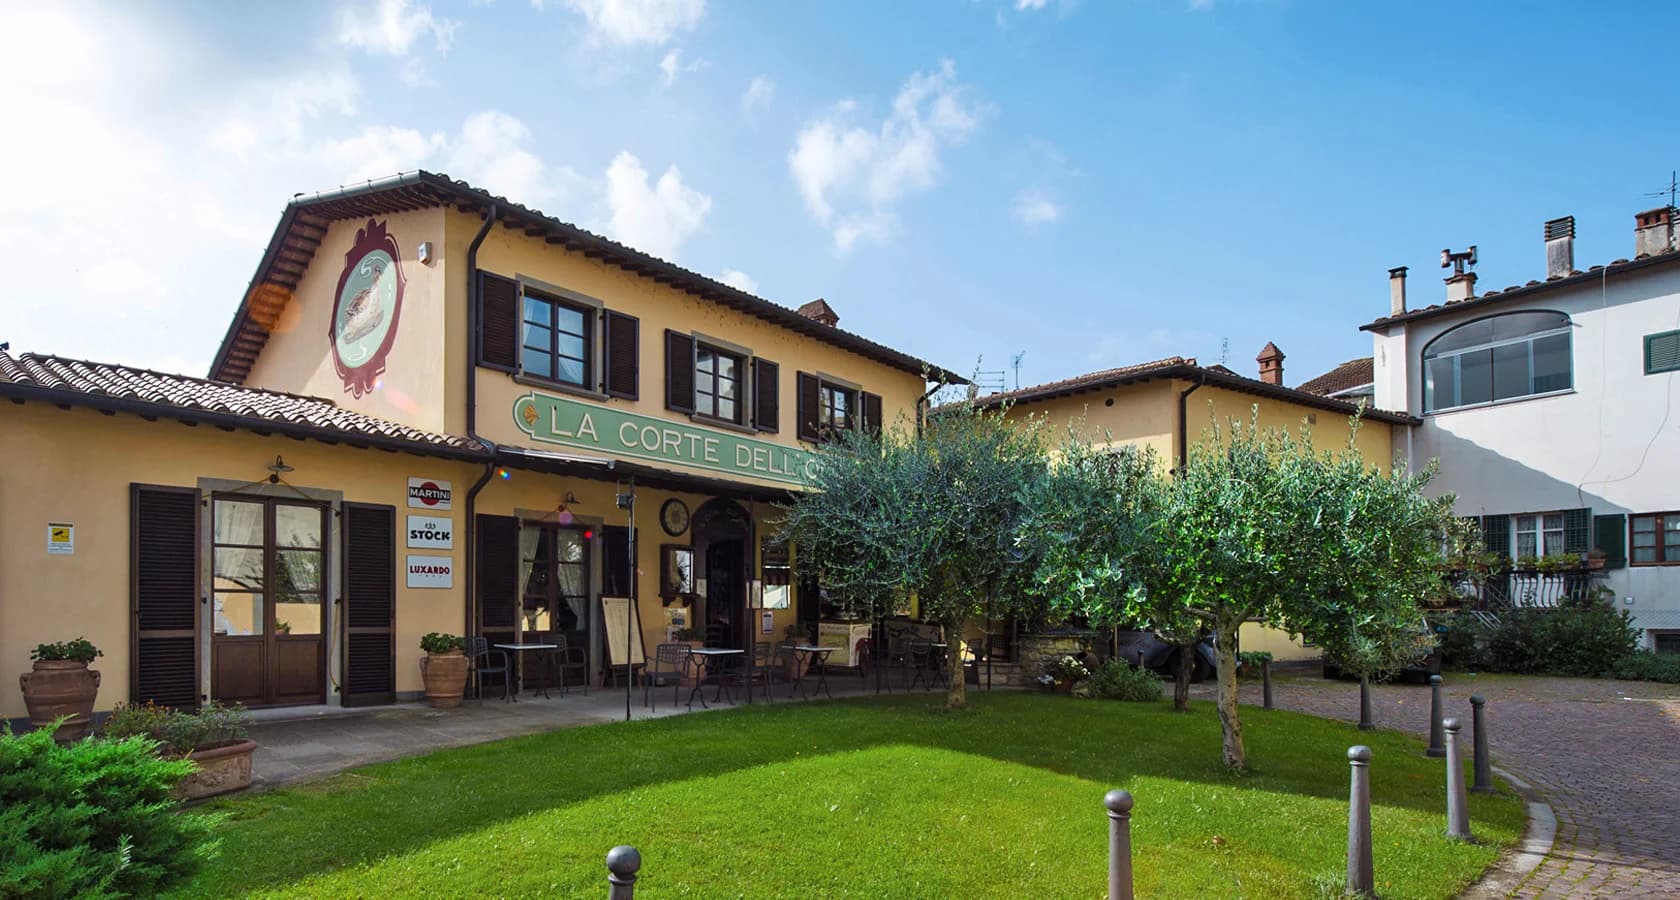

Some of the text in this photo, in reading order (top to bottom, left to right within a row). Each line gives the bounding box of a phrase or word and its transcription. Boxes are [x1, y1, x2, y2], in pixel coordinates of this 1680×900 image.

[551, 405, 599, 442] LA
[618, 421, 720, 463] CORTE
[409, 487, 450, 500] MARTINI
[410, 529, 450, 541] STOCK
[409, 565, 450, 575] LUXARDO
